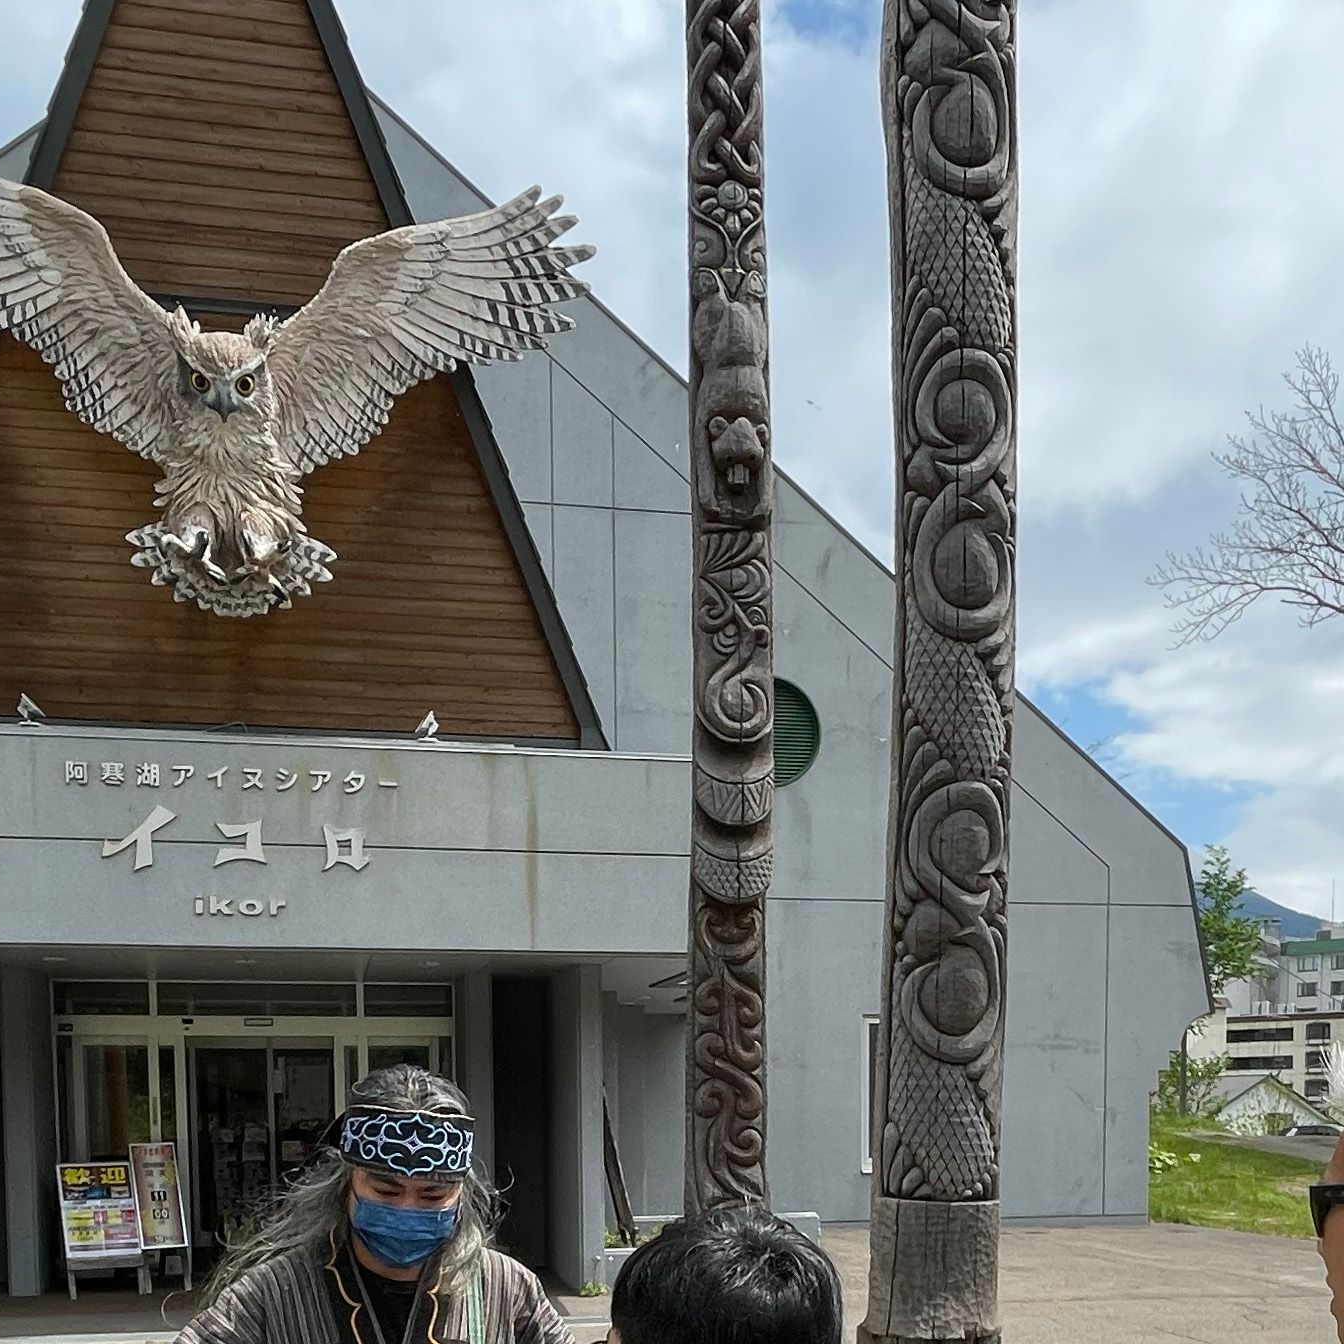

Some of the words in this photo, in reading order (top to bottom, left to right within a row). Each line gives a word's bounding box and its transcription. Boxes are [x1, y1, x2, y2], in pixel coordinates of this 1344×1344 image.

[65, 760, 399, 793] 阿寒湖アイヌシアター
[102, 805, 370, 871] イコロ
[194, 895, 287, 916] ikor
